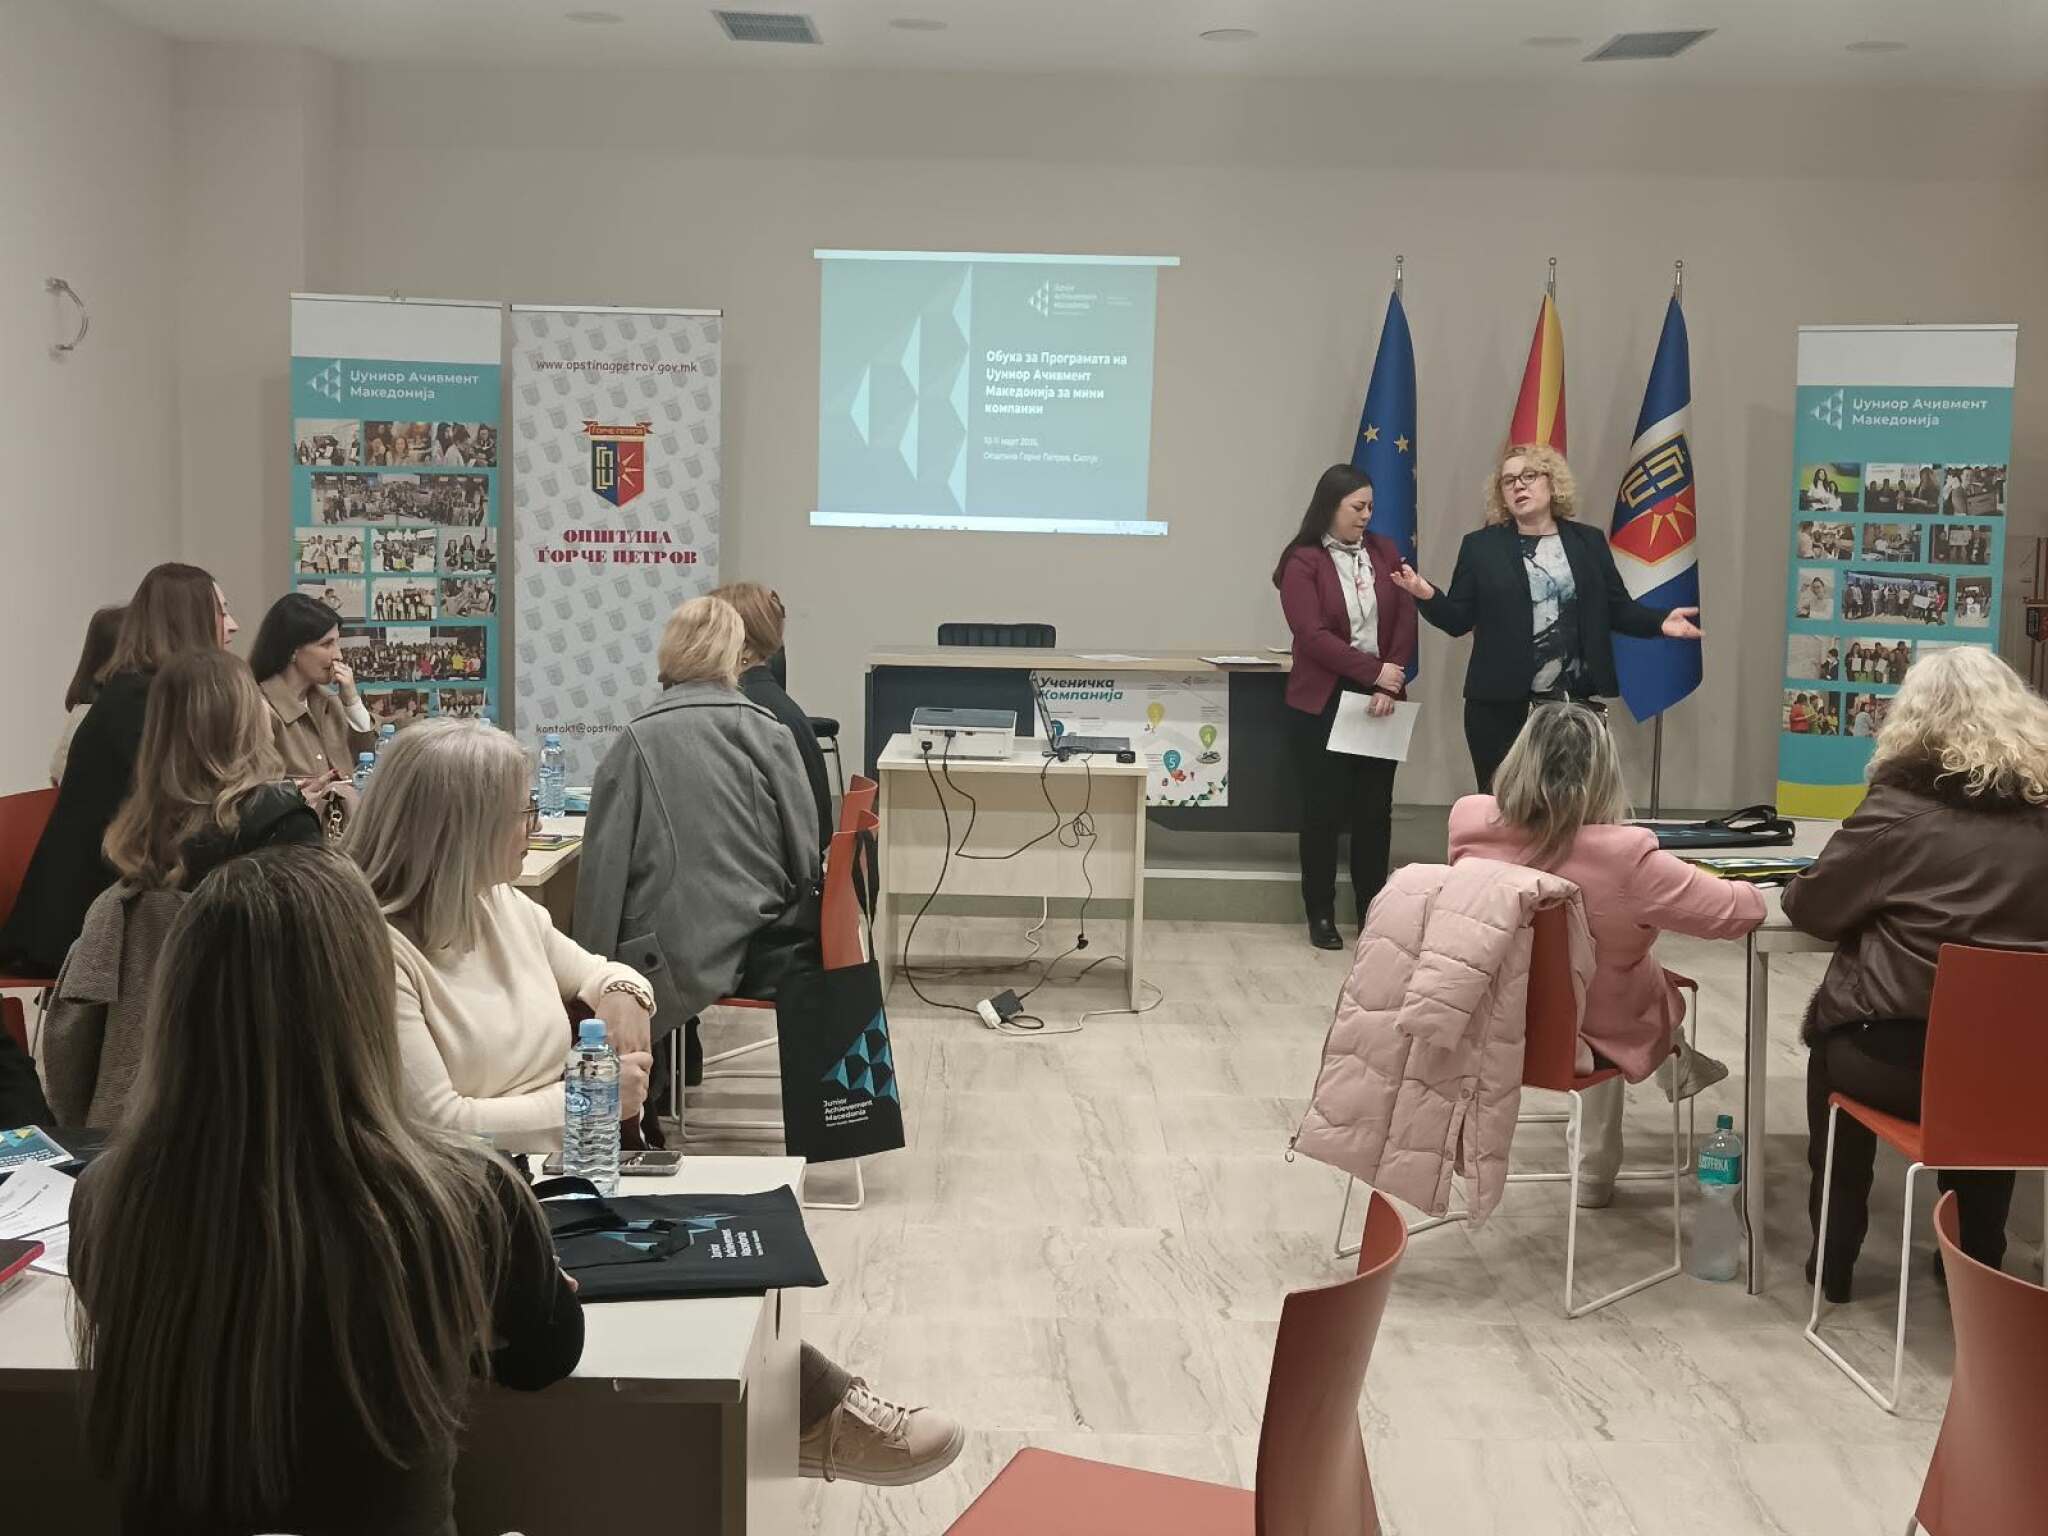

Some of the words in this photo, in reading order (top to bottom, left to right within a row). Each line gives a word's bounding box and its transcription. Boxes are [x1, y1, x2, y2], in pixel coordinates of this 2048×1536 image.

[986, 350, 1023, 365] Обука
[1025, 353, 1038, 363] за
[1041, 351, 1110, 366] Програмата
[1113, 355, 1128, 365] на
[536, 359, 698, 375] www.opstinagpetrov.gov.mk
[350, 370, 405, 384] Џуниор
[408, 371, 480, 385] Ачивмент
[986, 368, 1031, 382] Џуниор
[1033, 369, 1092, 381] Ачивмент
[350, 385, 435, 401] Македонија
[985, 385, 1055, 400] Македонија
[1057, 388, 1070, 398] за
[1073, 389, 1104, 399] мини
[984, 403, 1044, 414] компании
[1853, 398, 1909, 412] Џуниор
[1912, 398, 1988, 410] Ачивмент
[1852, 414, 1940, 428] Македонија
[563, 529, 672, 544] ОПШТИНА
[536, 545, 607, 563] ЃОРЧЕ
[613, 549, 697, 564] ПЕТРОВ
[1040, 676, 1115, 689] Ученичка
